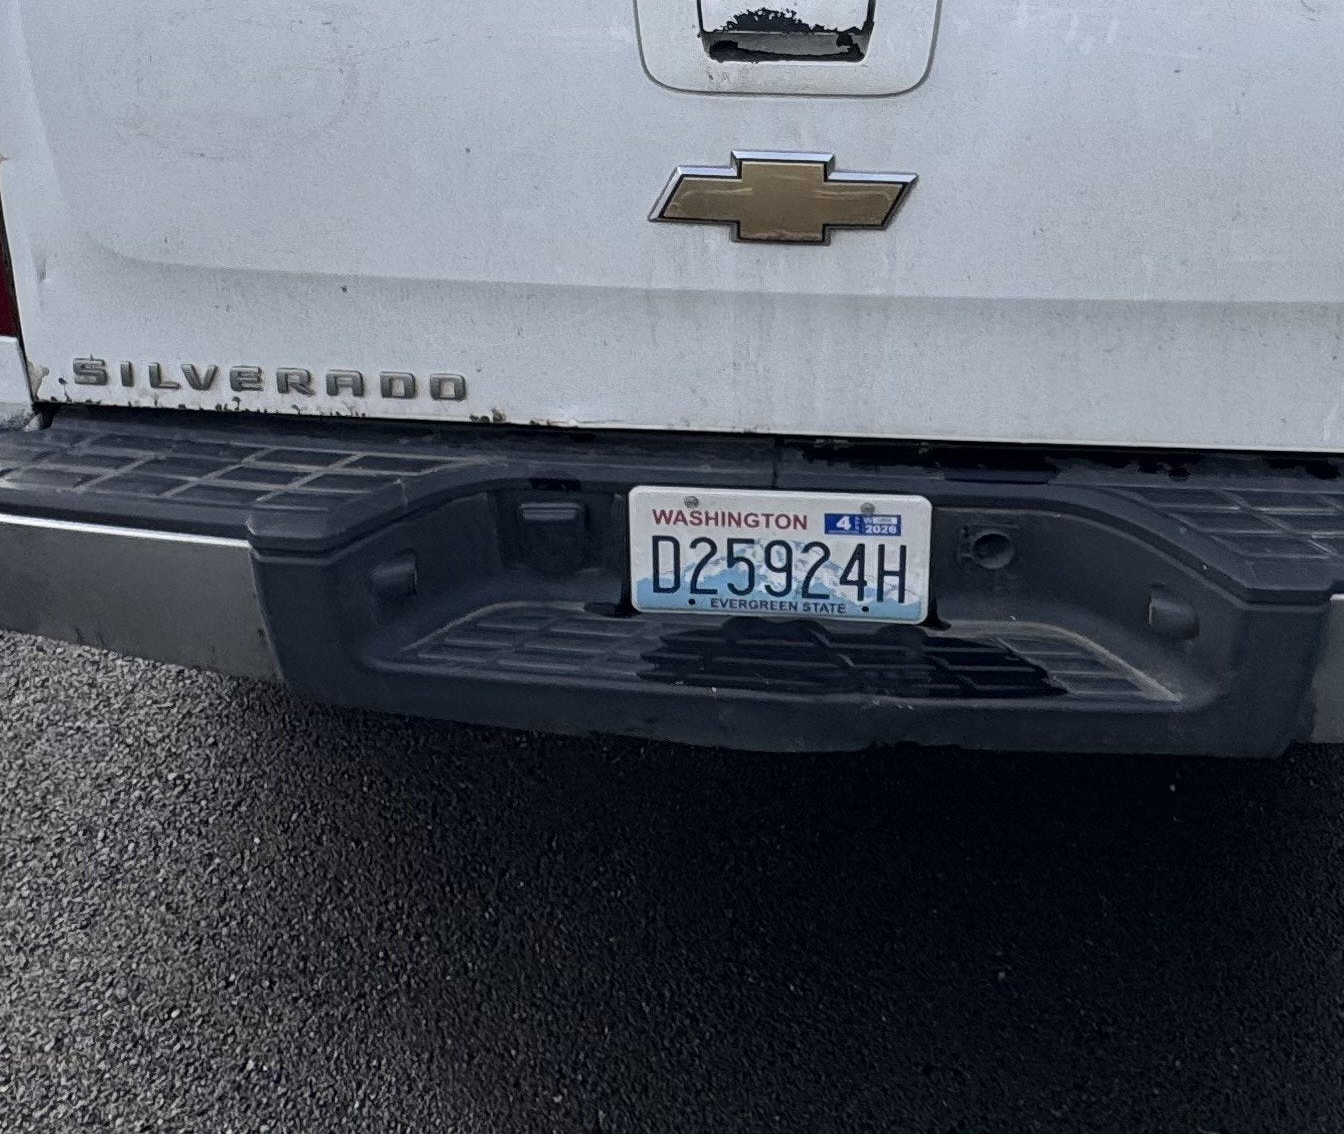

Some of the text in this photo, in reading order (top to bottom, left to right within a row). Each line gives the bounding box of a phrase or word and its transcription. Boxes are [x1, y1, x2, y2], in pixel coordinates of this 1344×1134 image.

[73, 357, 468, 401] SILVERADO
[652, 508, 808, 531] WASHINGTON
[836, 515, 852, 530] 4
[864, 524, 897, 534] 2026
[651, 534, 907, 604] D25924H
[710, 597, 847, 614] EVERGREEN STATE
